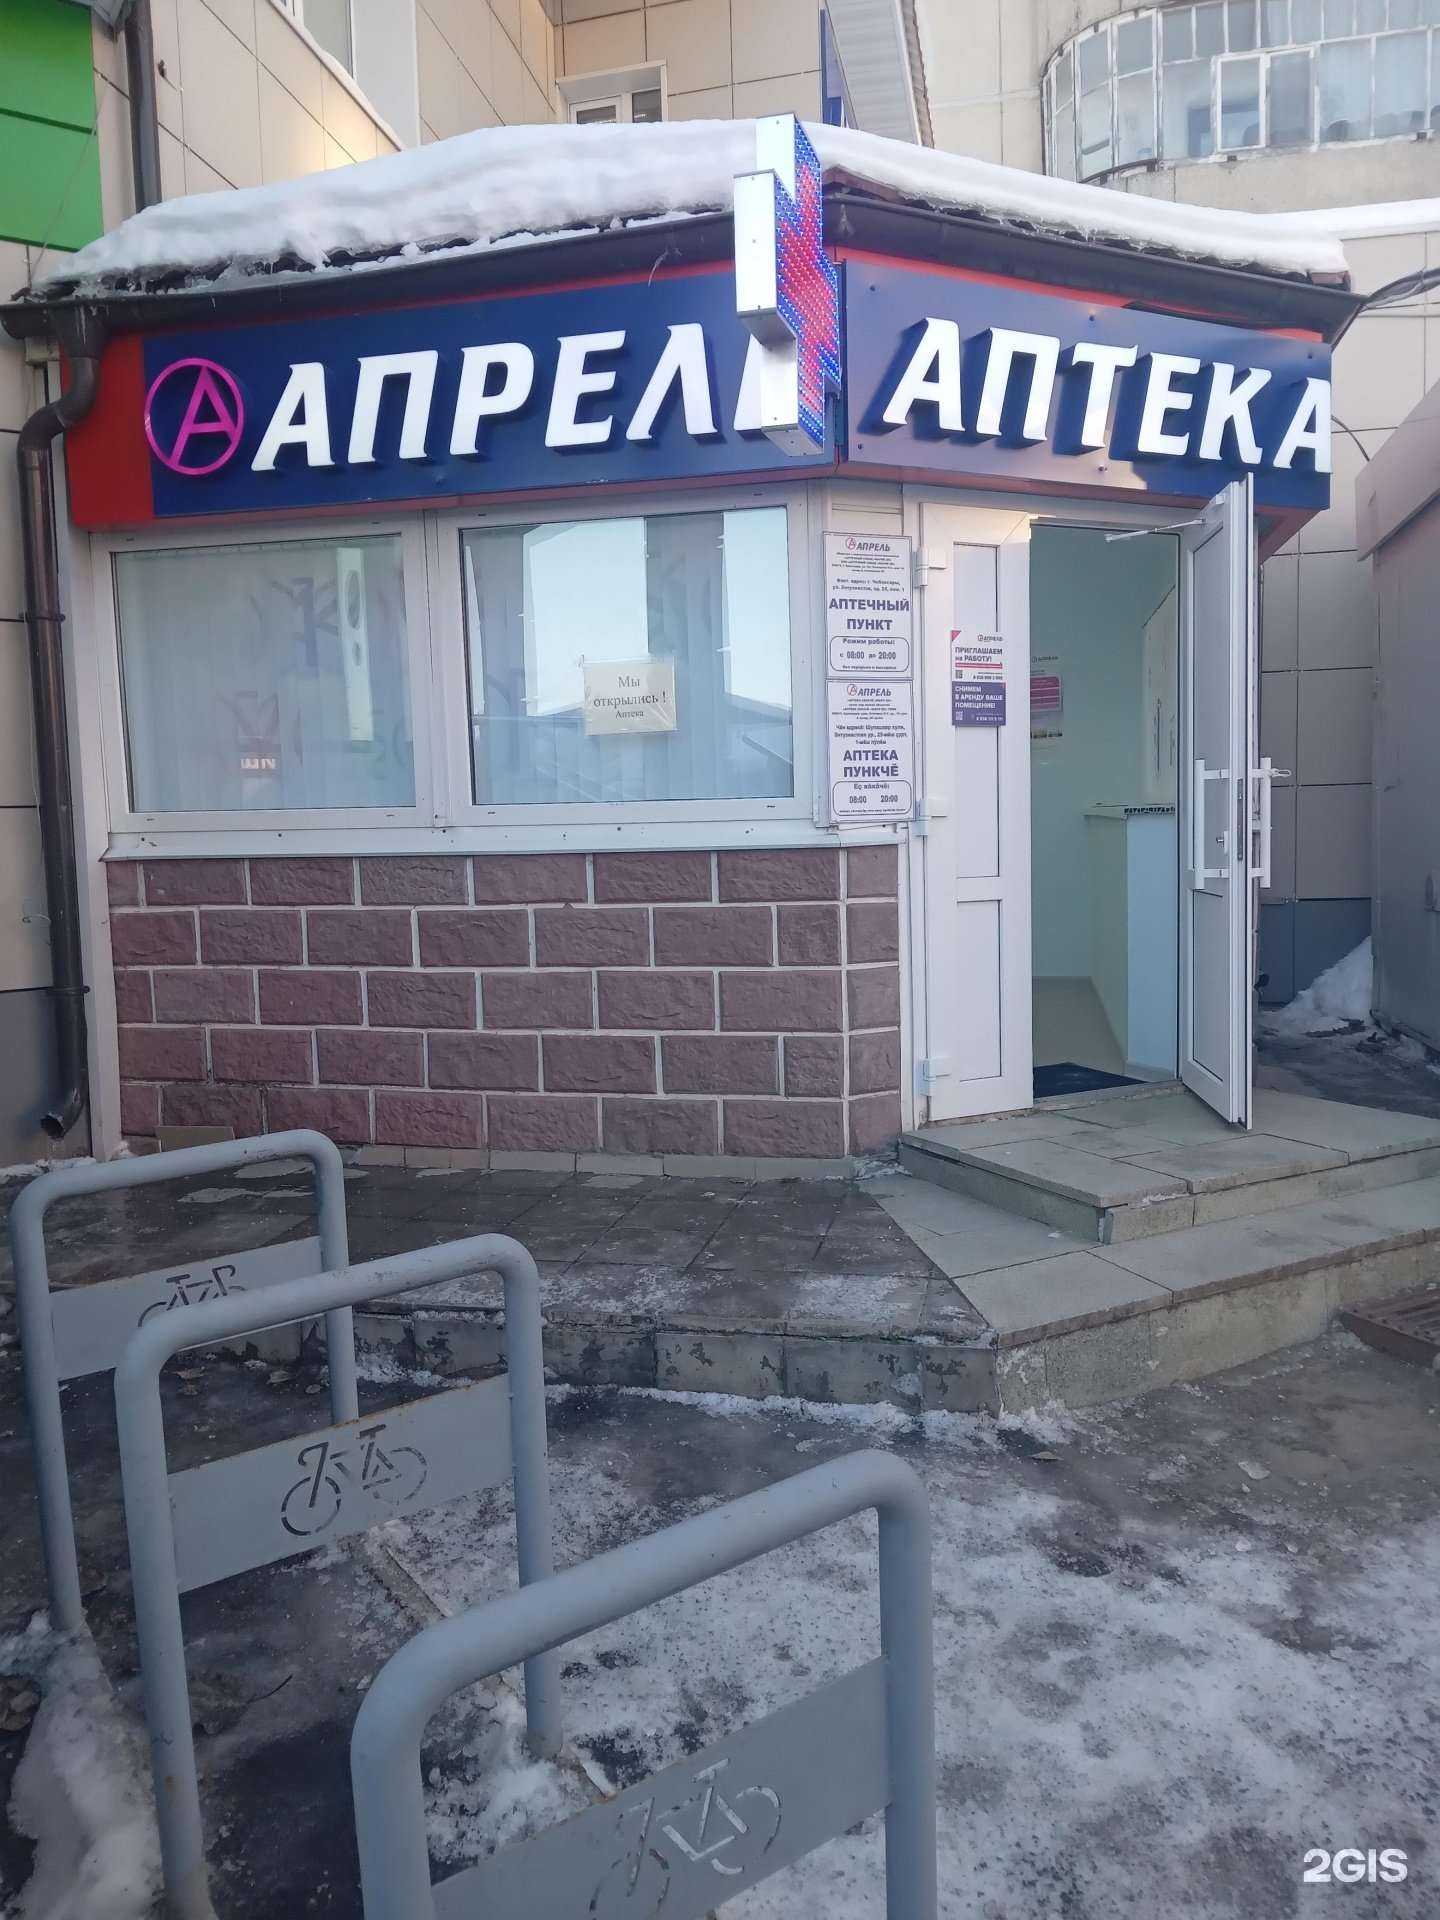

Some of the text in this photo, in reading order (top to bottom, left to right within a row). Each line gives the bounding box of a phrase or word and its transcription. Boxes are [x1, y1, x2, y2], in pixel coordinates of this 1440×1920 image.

[882, 316, 1333, 473] АПТЕКА
[857, 542, 890, 552] АПРЕЛЬ
[829, 598, 910, 611] АПТЕЧНЫЙ
[847, 618, 893, 630] ПУНКТ
[846, 651, 865, 660] 08:00
[878, 651, 897, 660] 20:00
[954, 647, 1003, 655] ПРИГЛАШАЕМ
[617, 675, 640, 688] Мы
[858, 688, 892, 696] АПРЕЛЬ
[593, 695, 659, 708] открылись
[615, 710, 644, 719] Аптека
[843, 750, 899, 761] АПТЕКА
[849, 794, 899, 804] 08:00 20:00
